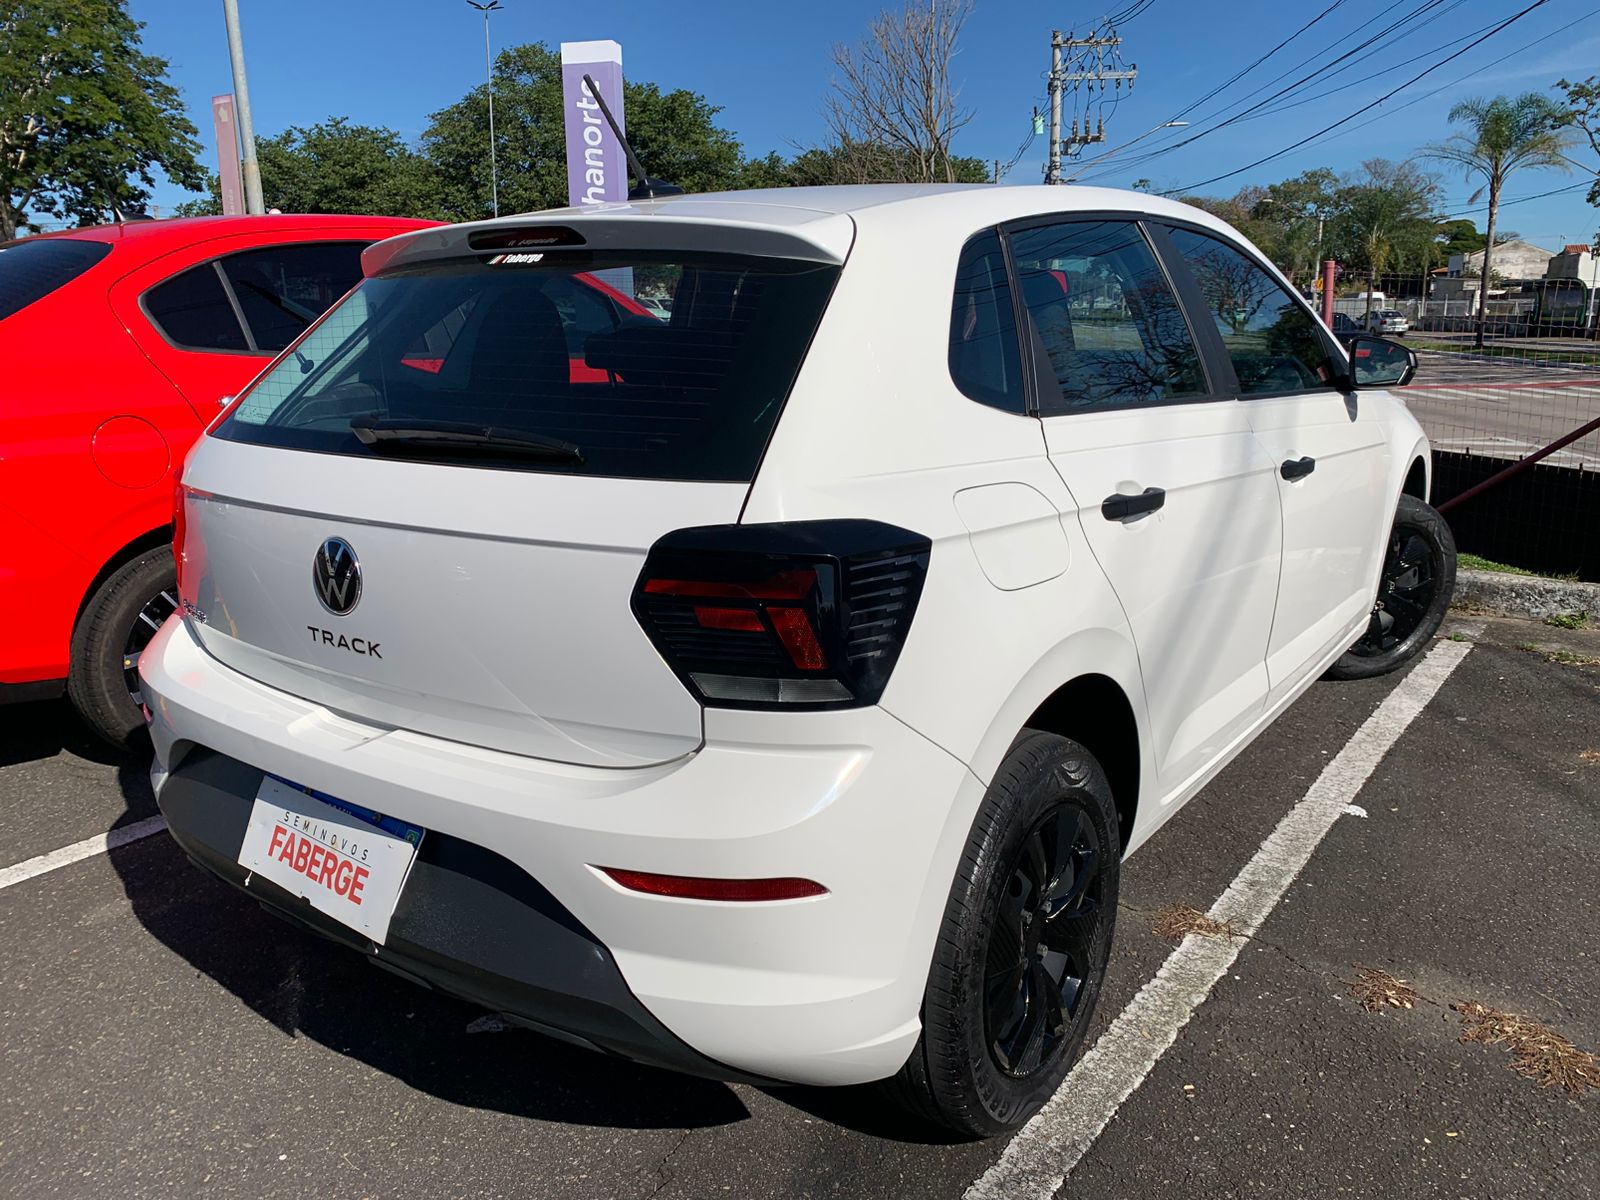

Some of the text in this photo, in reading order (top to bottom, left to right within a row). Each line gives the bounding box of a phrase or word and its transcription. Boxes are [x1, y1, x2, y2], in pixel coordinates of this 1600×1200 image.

[307, 626, 383, 659] TRACK
[283, 811, 369, 861] SEMINOVOS
[267, 824, 369, 906] FABERGE
